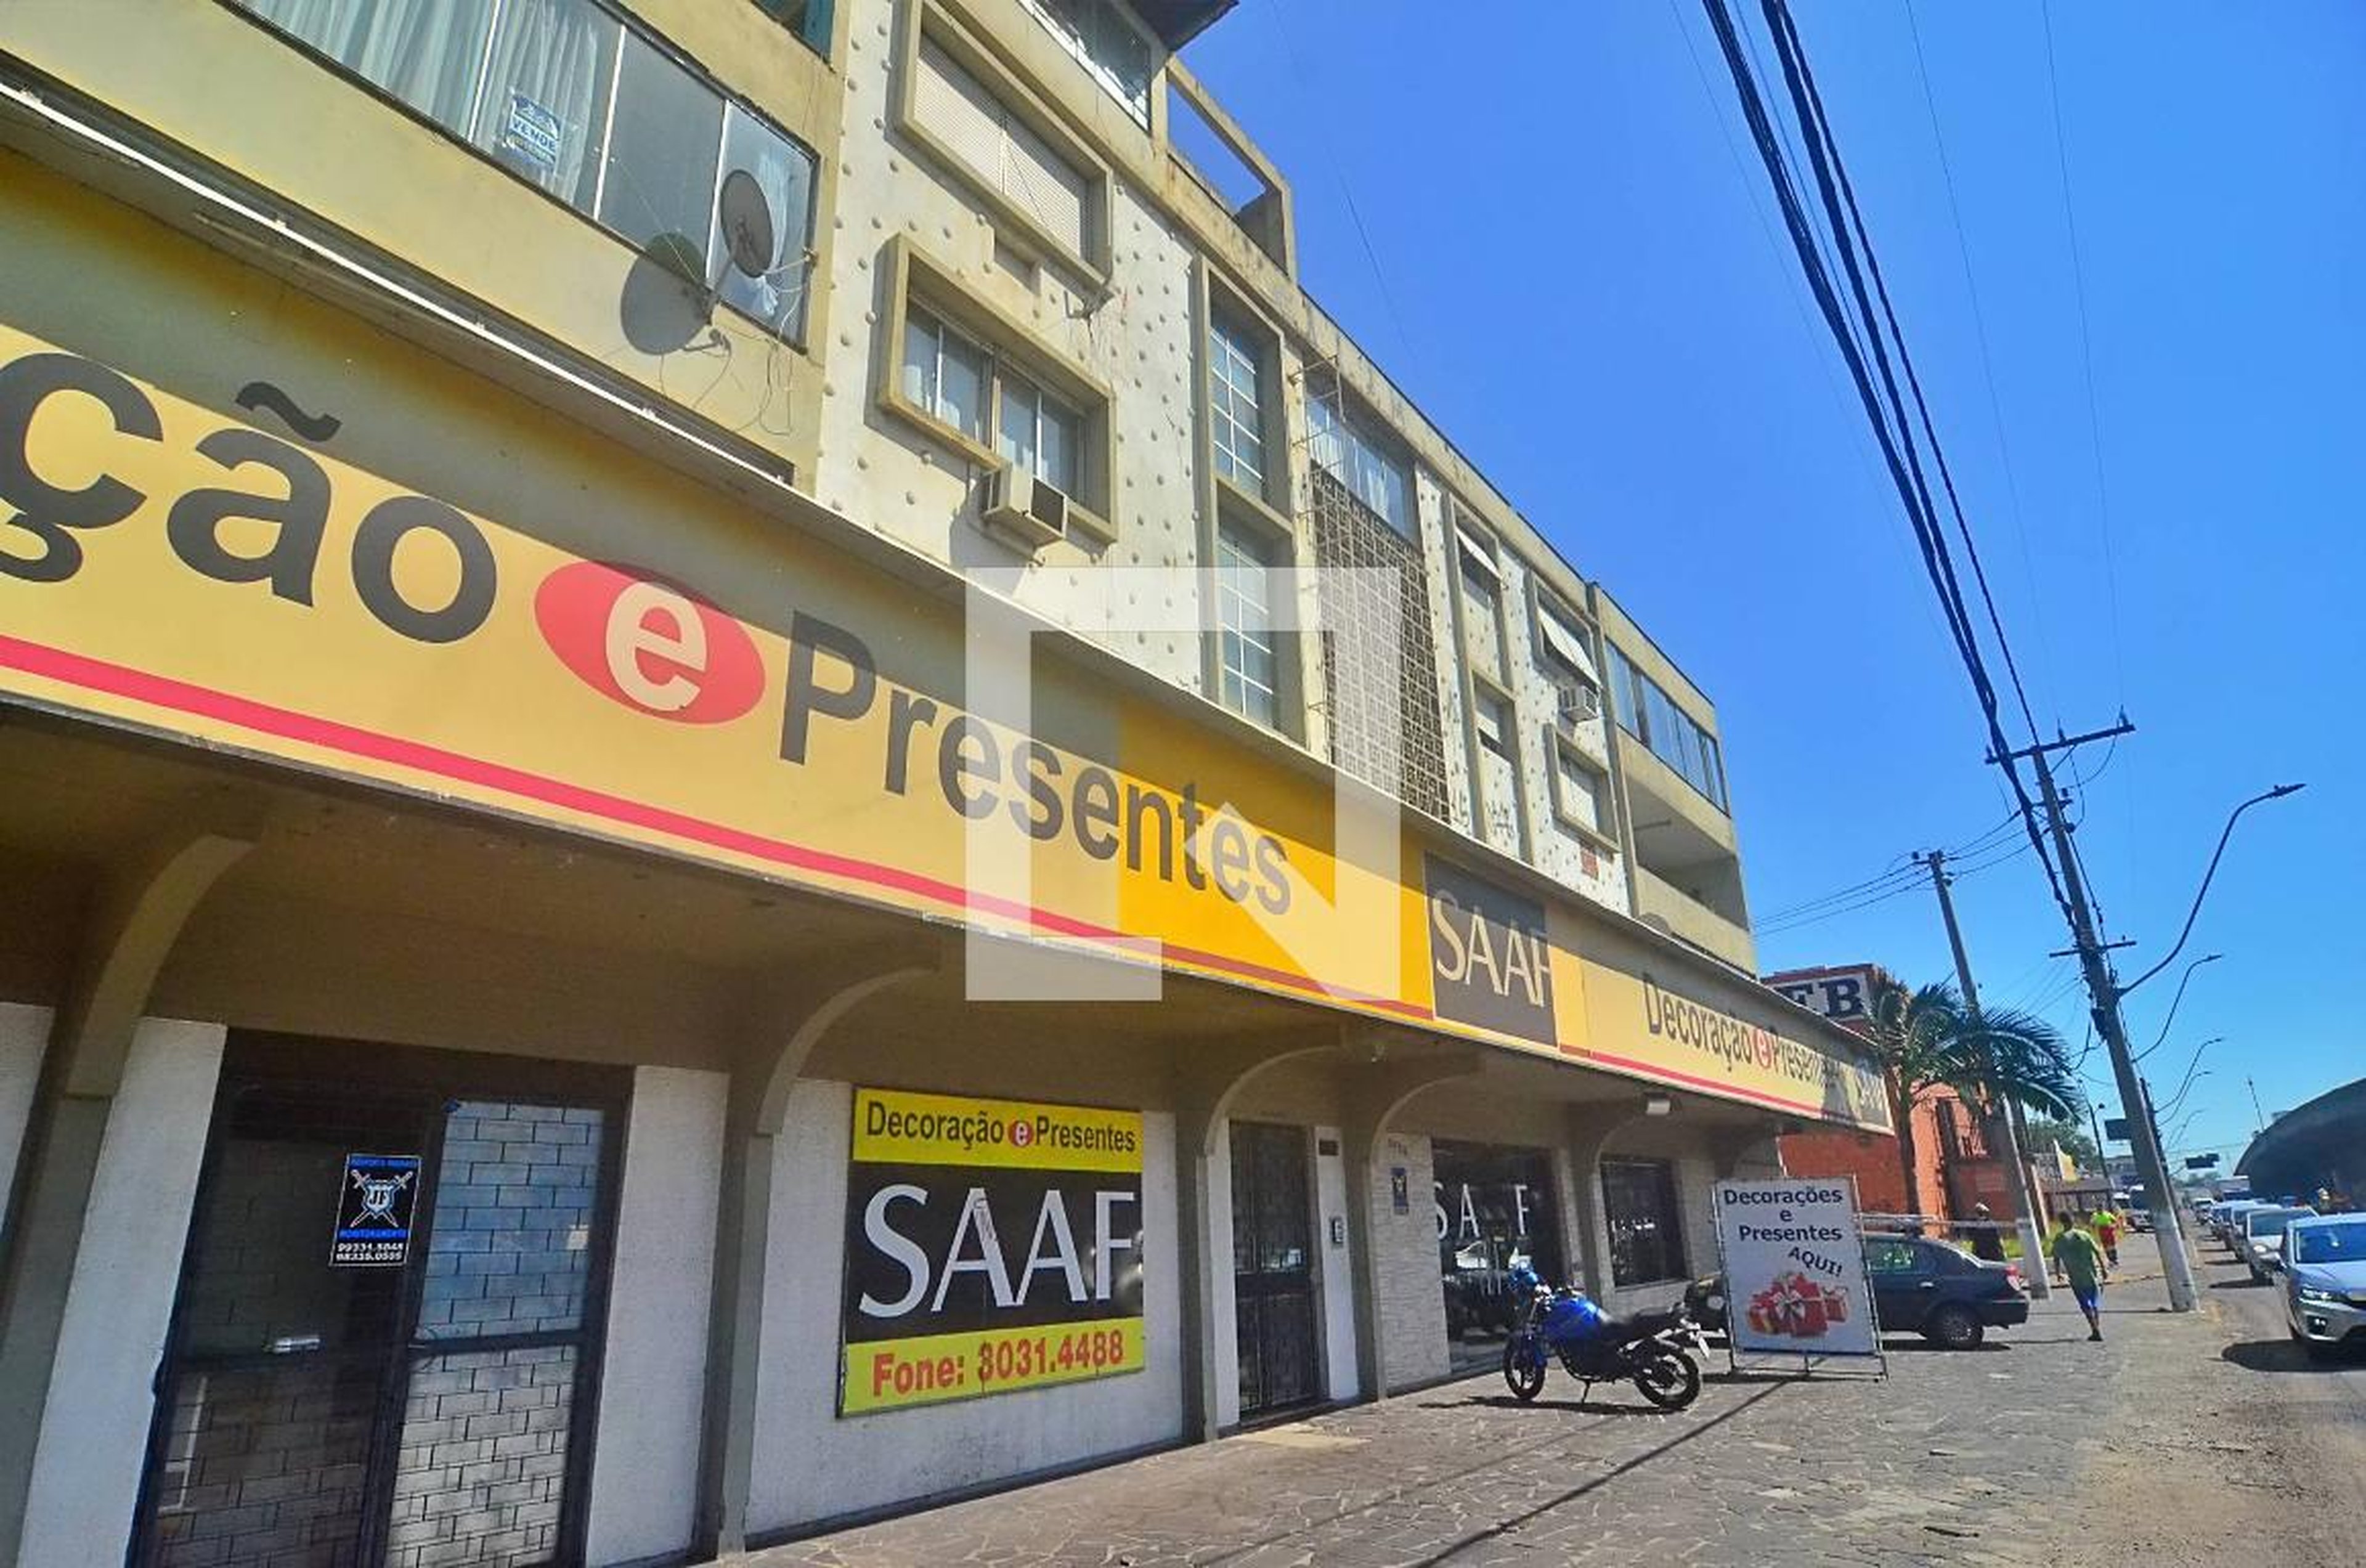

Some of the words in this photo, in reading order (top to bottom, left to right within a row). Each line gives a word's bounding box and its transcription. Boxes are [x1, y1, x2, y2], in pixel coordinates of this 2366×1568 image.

[605, 581, 708, 712] e
[779, 610, 1291, 916] Presentes
[1433, 889, 1550, 1007] SAAF
[866, 1100, 1004, 1150] Decoração
[1015, 1120, 1029, 1147] e
[1035, 1115, 1136, 1153] Presentes
[1723, 1187, 1843, 1207] Decorações
[1779, 1209, 1793, 1222] e
[858, 1184, 1135, 1319] SAAF
[1738, 1225, 1843, 1241] Presentes
[1787, 1246, 1844, 1278] AQUI!
[872, 1353, 965, 1397] Fone:
[978, 1328, 1123, 1381] 8031.4488
